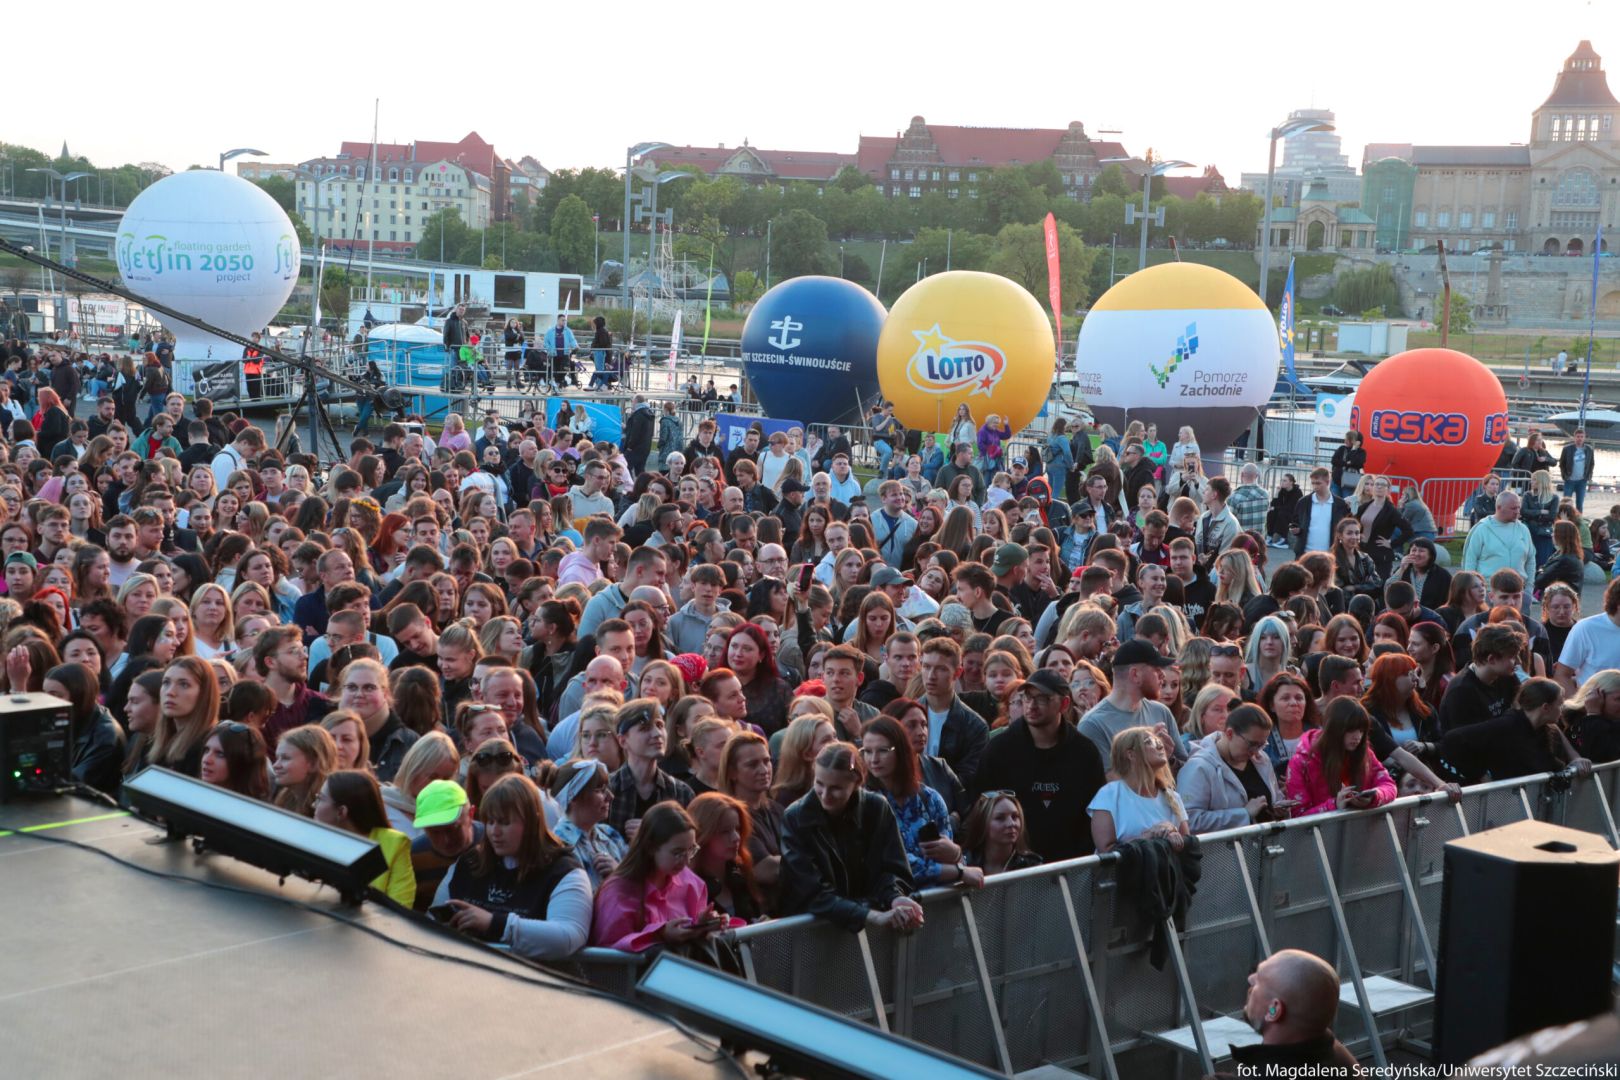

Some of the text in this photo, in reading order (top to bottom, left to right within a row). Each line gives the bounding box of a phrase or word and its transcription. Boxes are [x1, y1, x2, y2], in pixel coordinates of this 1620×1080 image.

[174, 240, 250, 254] floating garden
[200, 254, 254, 271] 2050
[216, 273, 251, 283] project
[751, 352, 852, 372] SZCZECIN-ŚWINOUJŚCIE
[926, 354, 985, 381] LOTTO
[1194, 370, 1248, 383] Pomorze
[1180, 384, 1242, 396] Zachodnie
